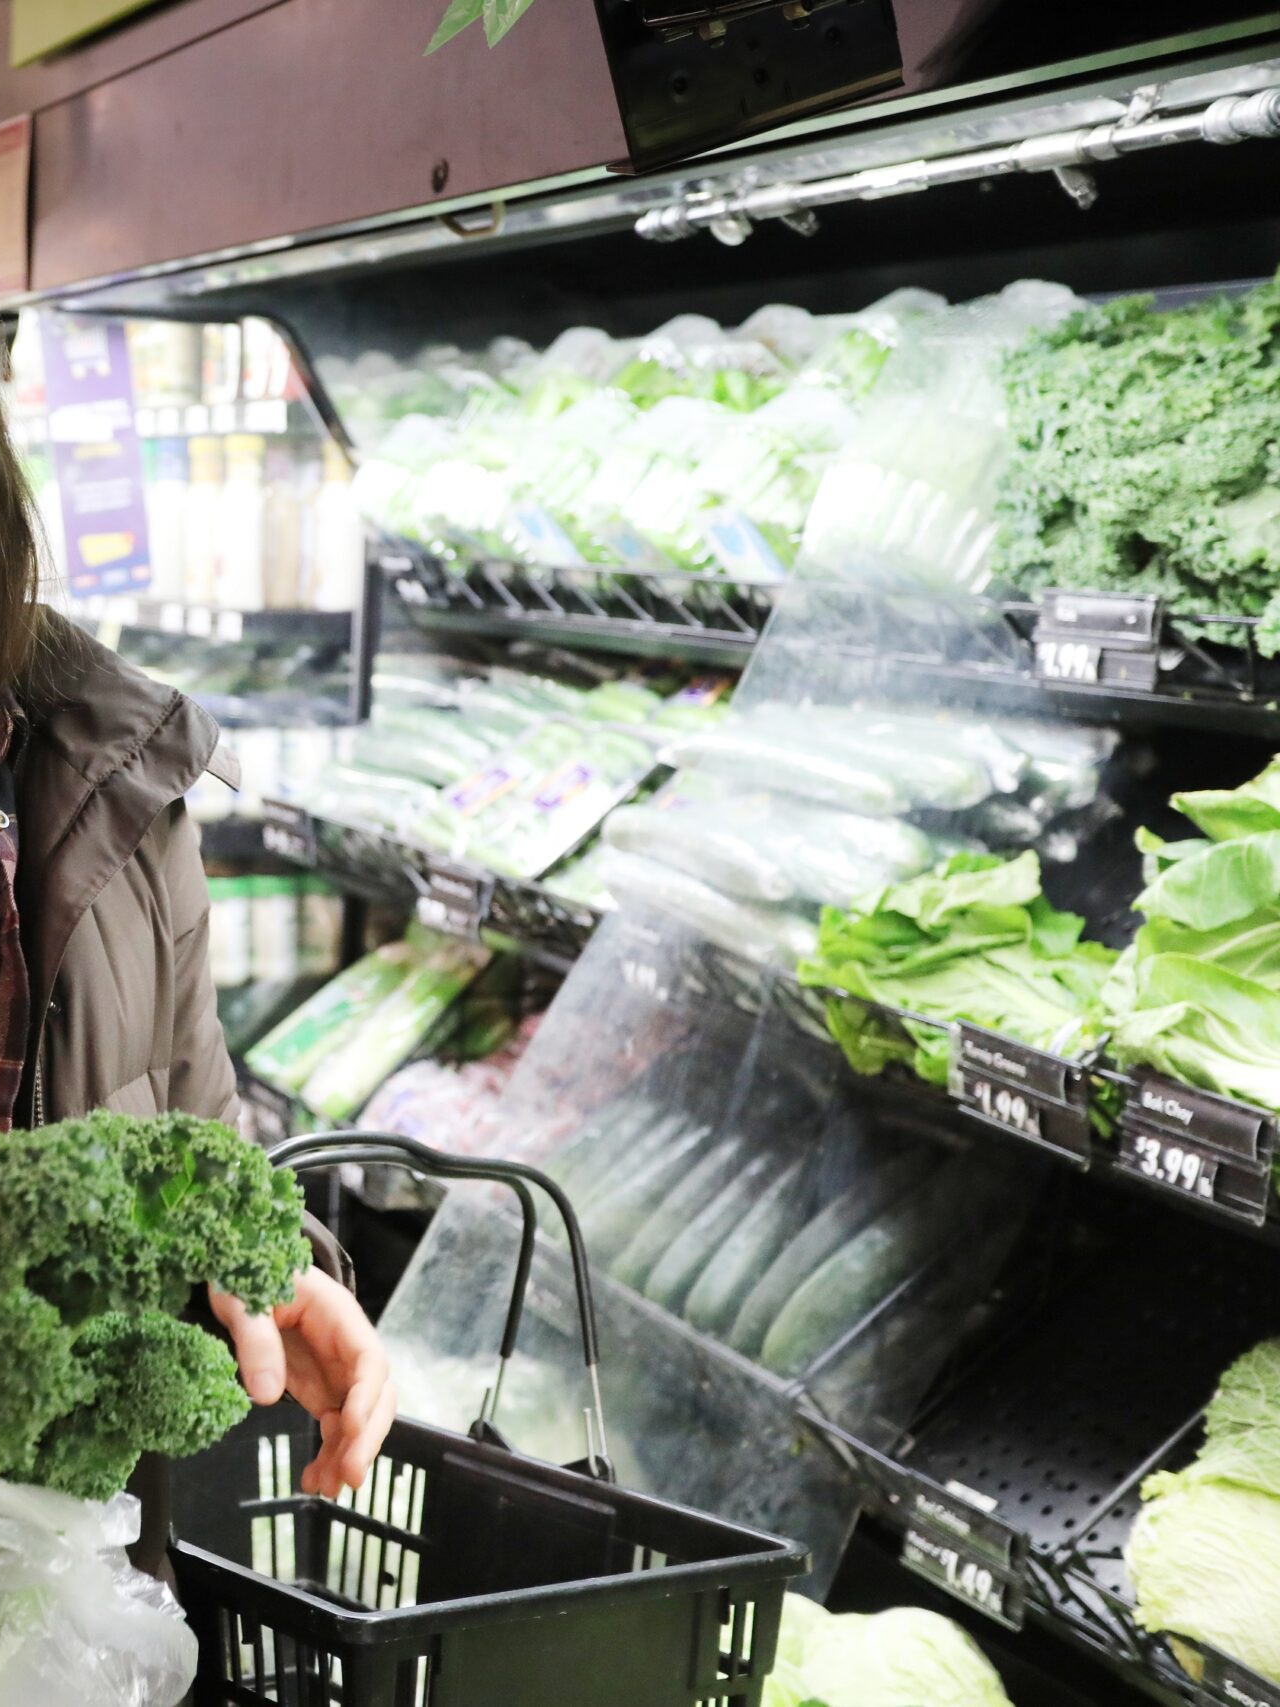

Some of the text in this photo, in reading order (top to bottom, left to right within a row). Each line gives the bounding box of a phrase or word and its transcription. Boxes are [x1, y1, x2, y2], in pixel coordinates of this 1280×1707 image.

[1143, 1091, 1193, 1126] Bok Choy
[1135, 1136, 1201, 1191] $3.99
